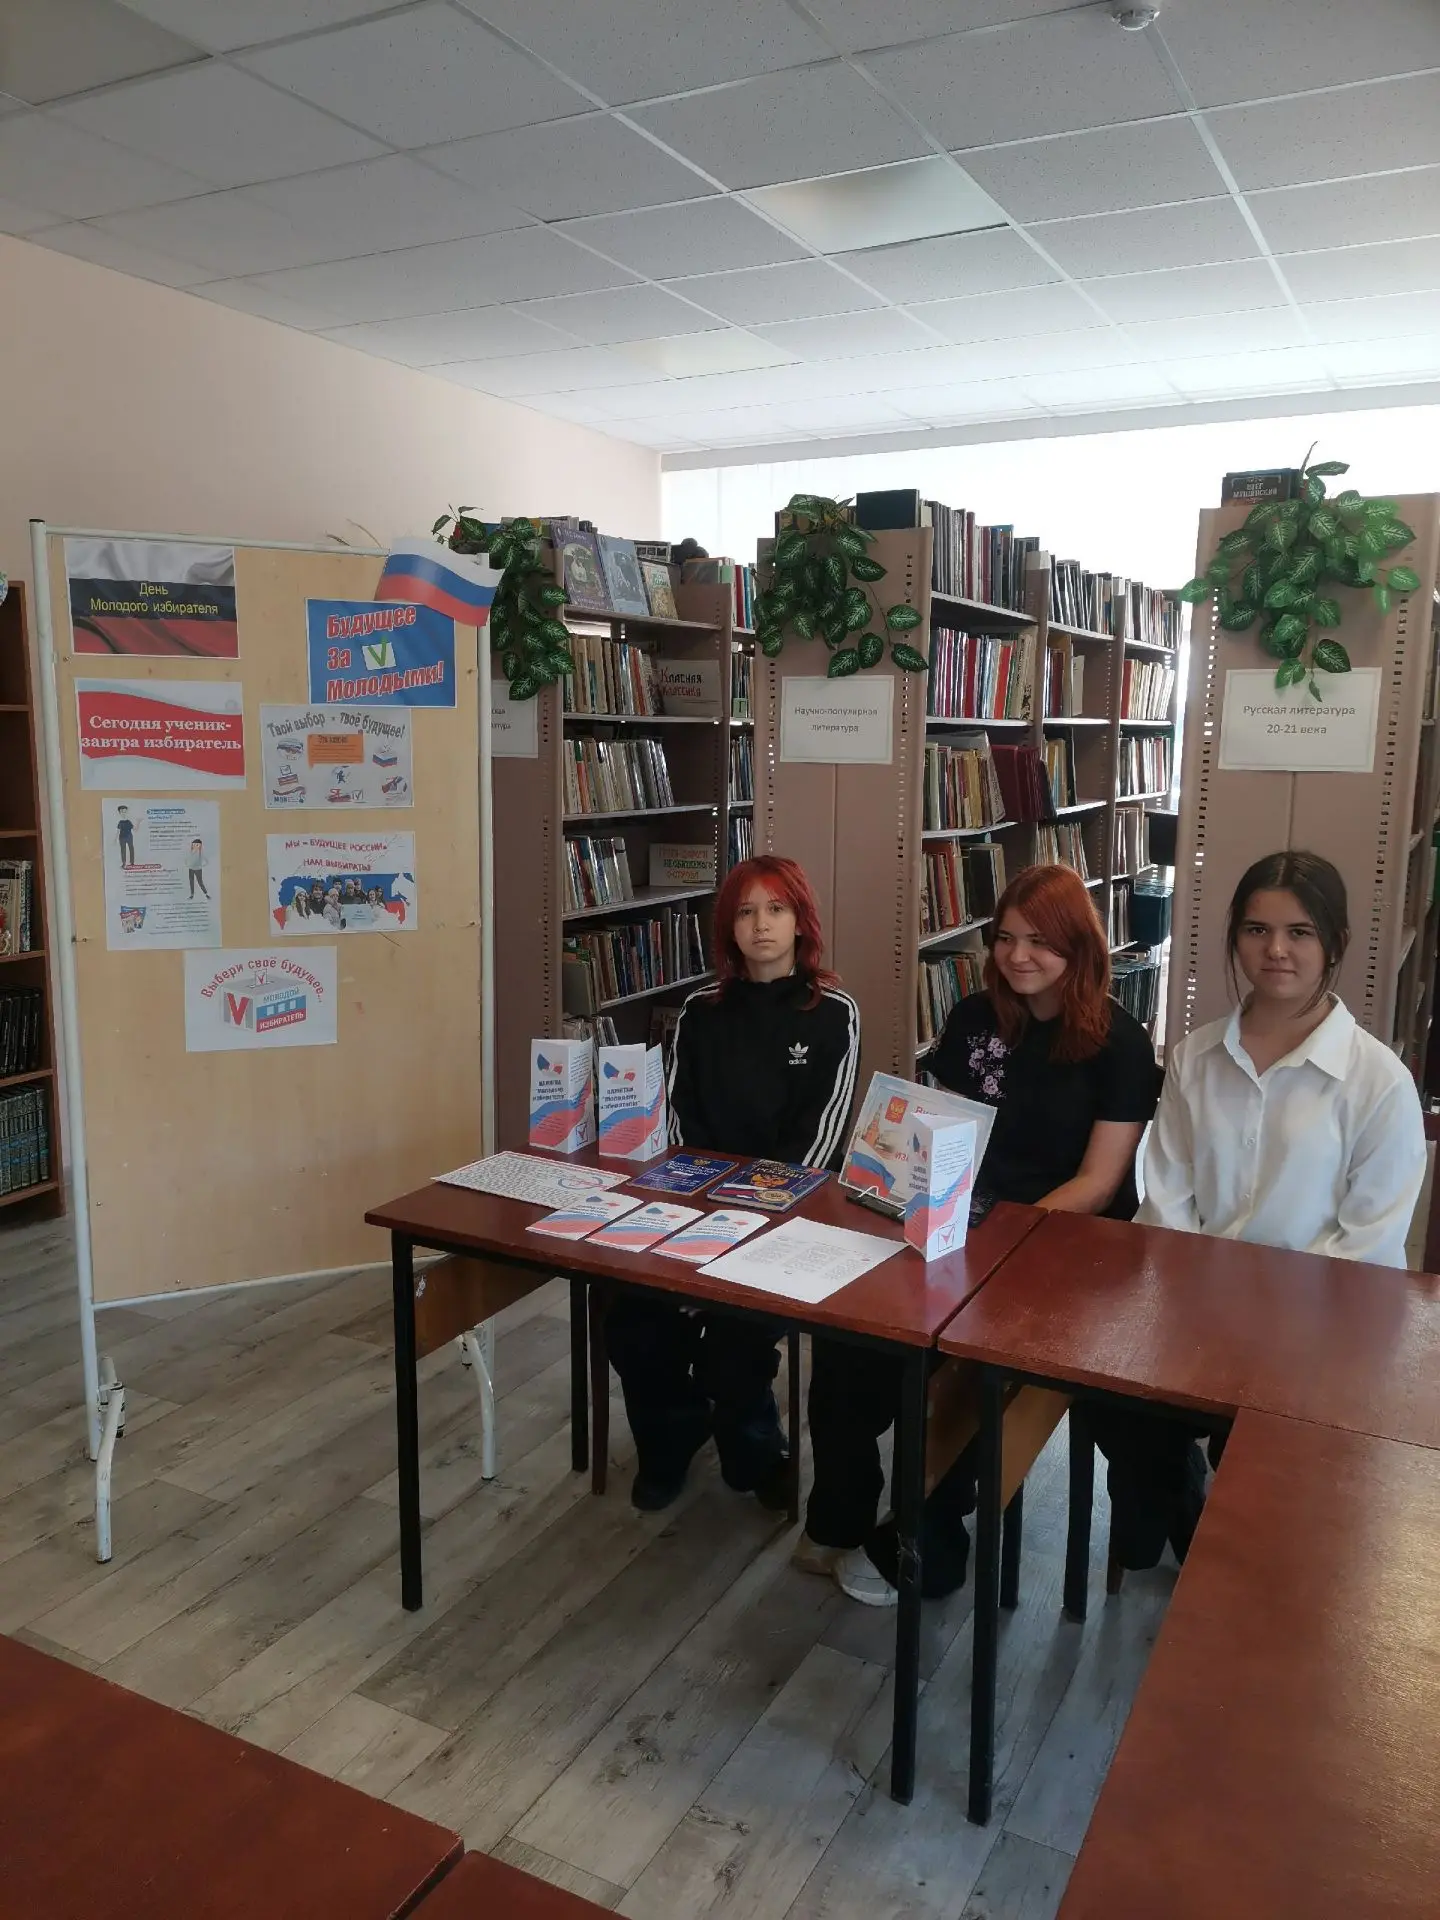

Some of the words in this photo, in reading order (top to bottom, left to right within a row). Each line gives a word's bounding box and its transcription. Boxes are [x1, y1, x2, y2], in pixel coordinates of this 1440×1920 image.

[139, 583, 169, 597] День
[90, 599, 149, 613] Молодого
[153, 601, 219, 615] избирателя
[327, 606, 417, 638] Будущее
[327, 647, 352, 670] За
[327, 661, 444, 703] Молодыми!
[794, 707, 878, 718] Научно-популярная
[1242, 705, 1287, 717] Русская
[1289, 705, 1356, 718] литература
[89, 716, 162, 731] Сегодня
[165, 719, 232, 733] ученик-
[267, 719, 293, 738] Твой
[294, 711, 326, 731] выбор
[340, 712, 361, 727] твоё
[362, 715, 406, 739] будущее!
[811, 724, 859, 733] литература
[1266, 724, 1298, 735] 20-21
[1300, 725, 1327, 735] века
[81, 736, 140, 751] завтра
[144, 735, 242, 752] избиратель
[285, 840, 300, 851] МЫ
[310, 839, 346, 850] БУДУЩЕЕ
[303, 858, 322, 867] НАМ
[200, 964, 244, 998] Выбери
[248, 956, 277, 969] своё
[260, 1012, 304, 1029] ИЗБИРАТЕЛЬ
